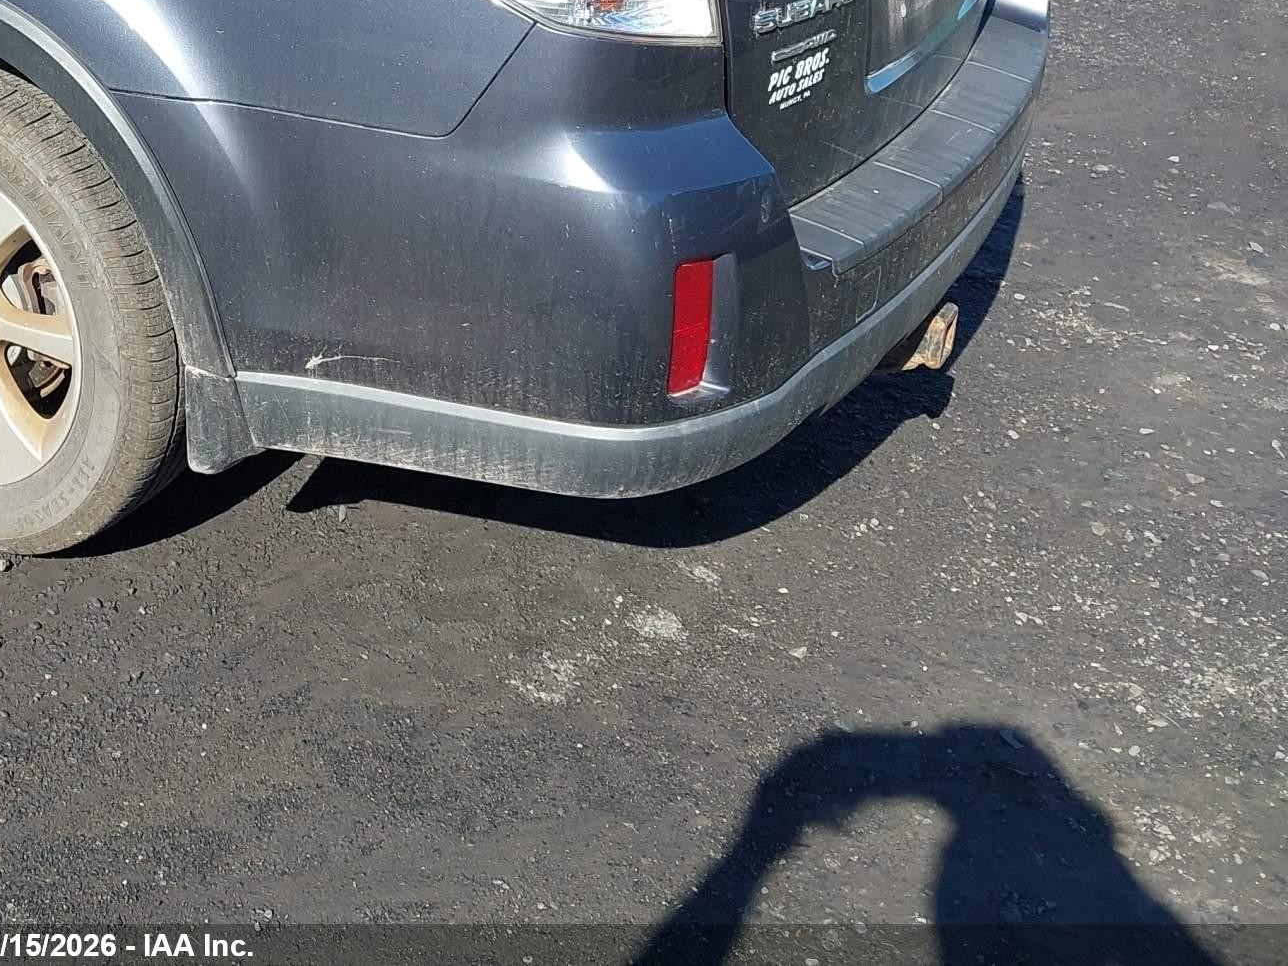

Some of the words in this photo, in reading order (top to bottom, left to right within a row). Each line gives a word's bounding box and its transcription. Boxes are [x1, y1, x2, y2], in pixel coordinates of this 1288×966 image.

[767, 65, 793, 92] PIC
[794, 47, 830, 80] BROS.
[768, 82, 797, 105] AUTO
[796, 67, 825, 93] SALES
